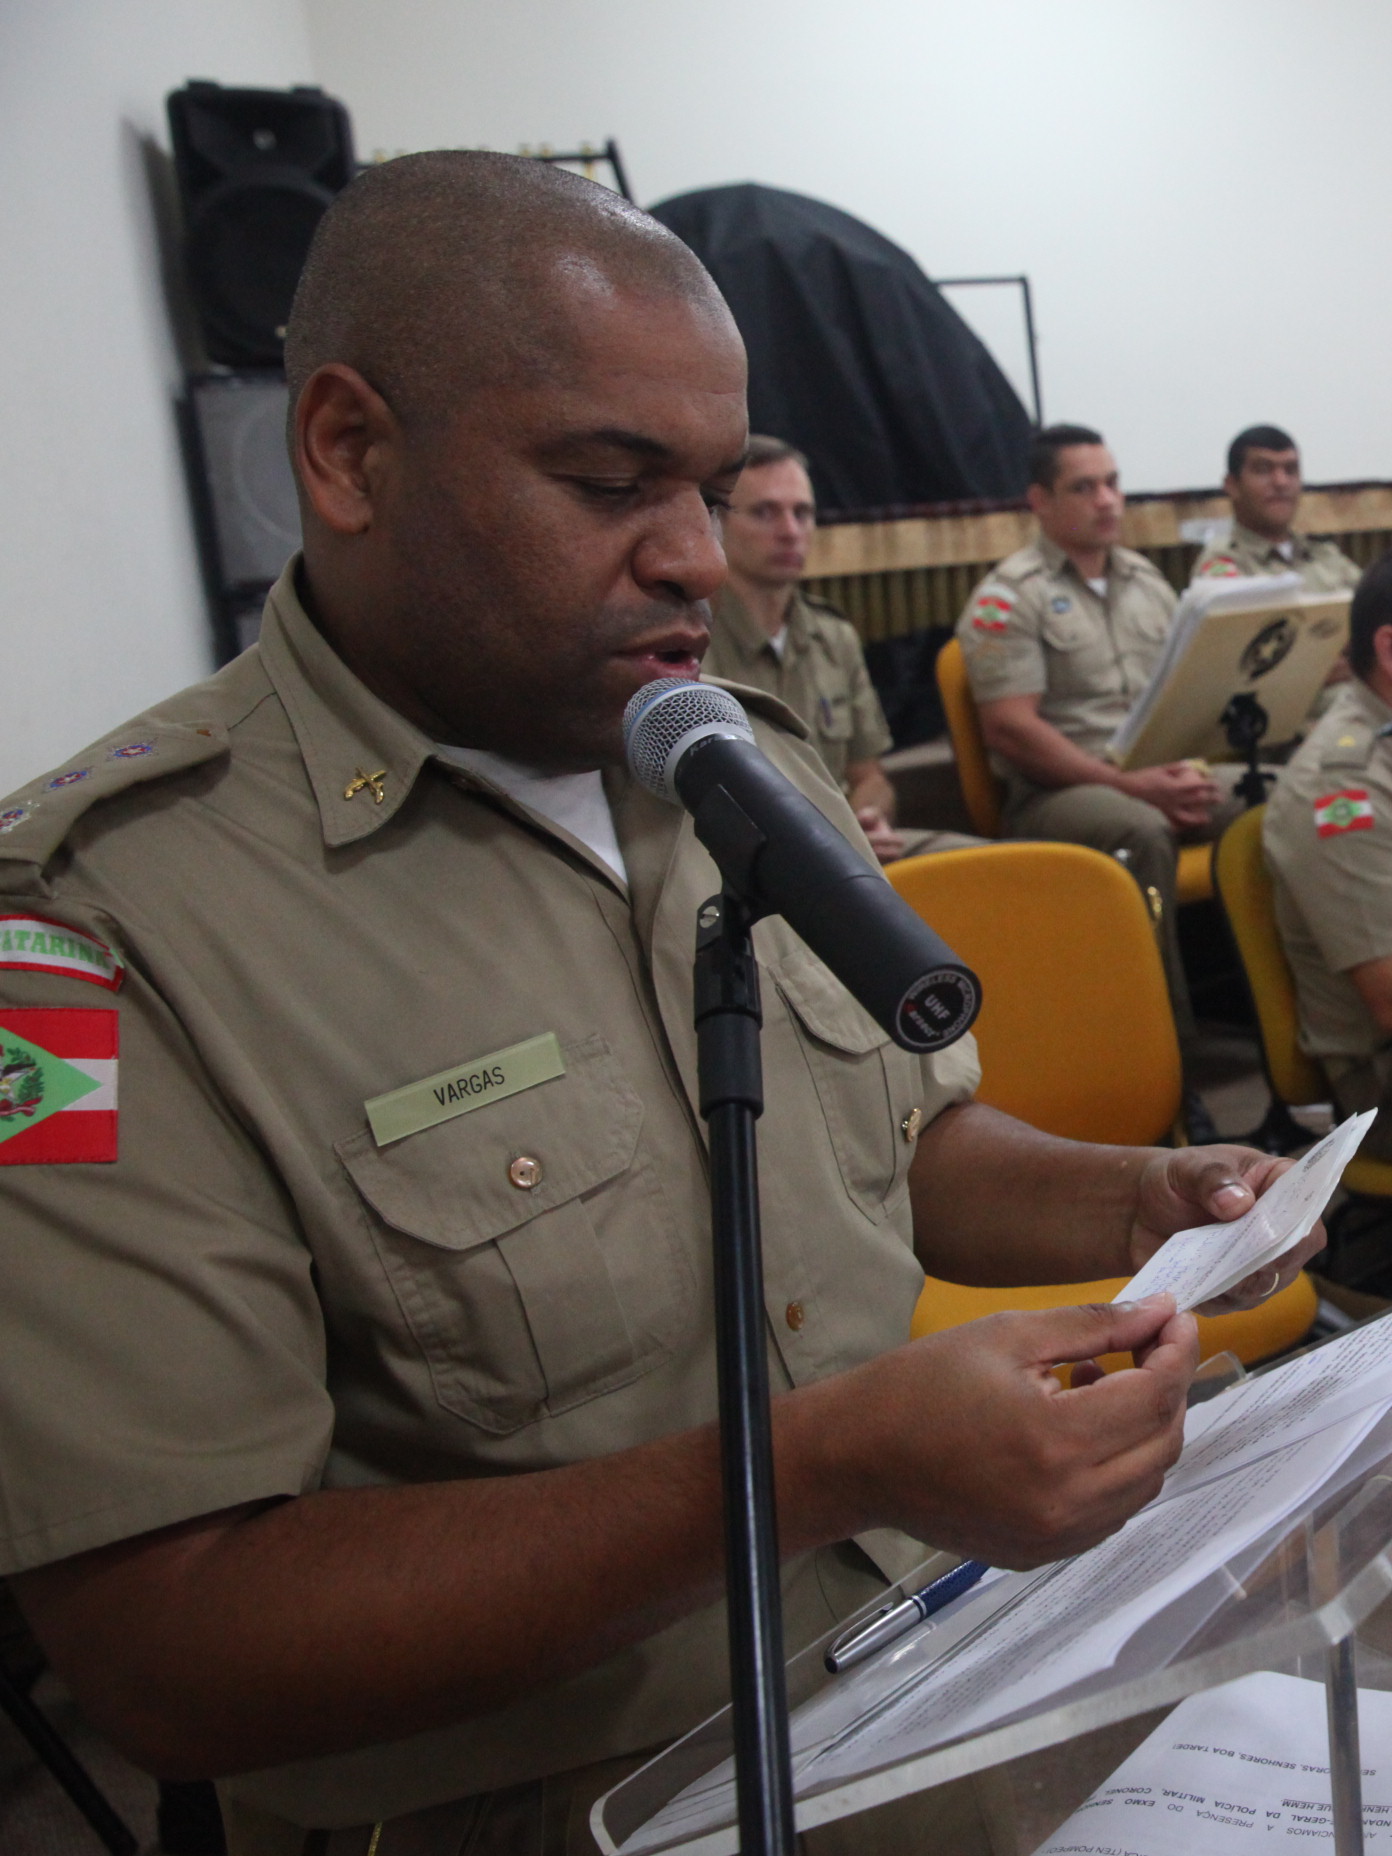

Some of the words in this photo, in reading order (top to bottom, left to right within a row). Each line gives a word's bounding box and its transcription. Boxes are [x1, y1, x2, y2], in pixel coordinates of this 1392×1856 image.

[924, 994, 951, 1020] UHF
[433, 1066, 505, 1106] VARGAS
[1171, 1742, 1209, 1753] TARDE!
[1213, 1746, 1236, 1758] BOA
[1123, 1797, 1156, 1808] EXMO
[1166, 1802, 1185, 1813] DO
[1214, 1800, 1257, 1816] POLÍCIA
[1196, 1809, 1255, 1829] PRESENÇA
[1265, 1810, 1282, 1820] DA
[1266, 1823, 1276, 1832] A
